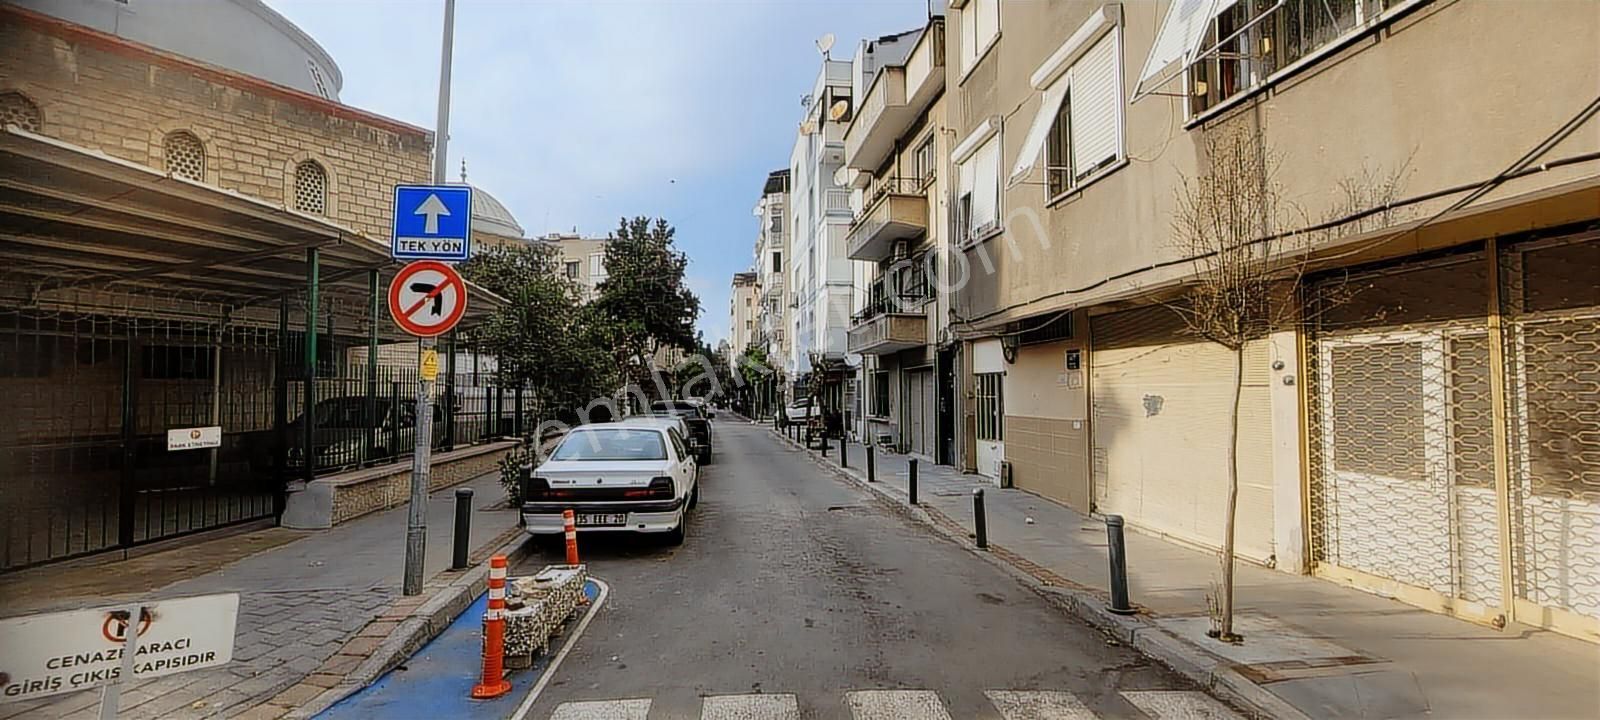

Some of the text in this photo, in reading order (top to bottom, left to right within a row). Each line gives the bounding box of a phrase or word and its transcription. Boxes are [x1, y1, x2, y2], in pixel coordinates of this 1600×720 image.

[400, 240, 461, 252] TEK YÖN
[135, 638, 190, 656] ARACI
[5, 676, 62, 696] GİRİŞ
